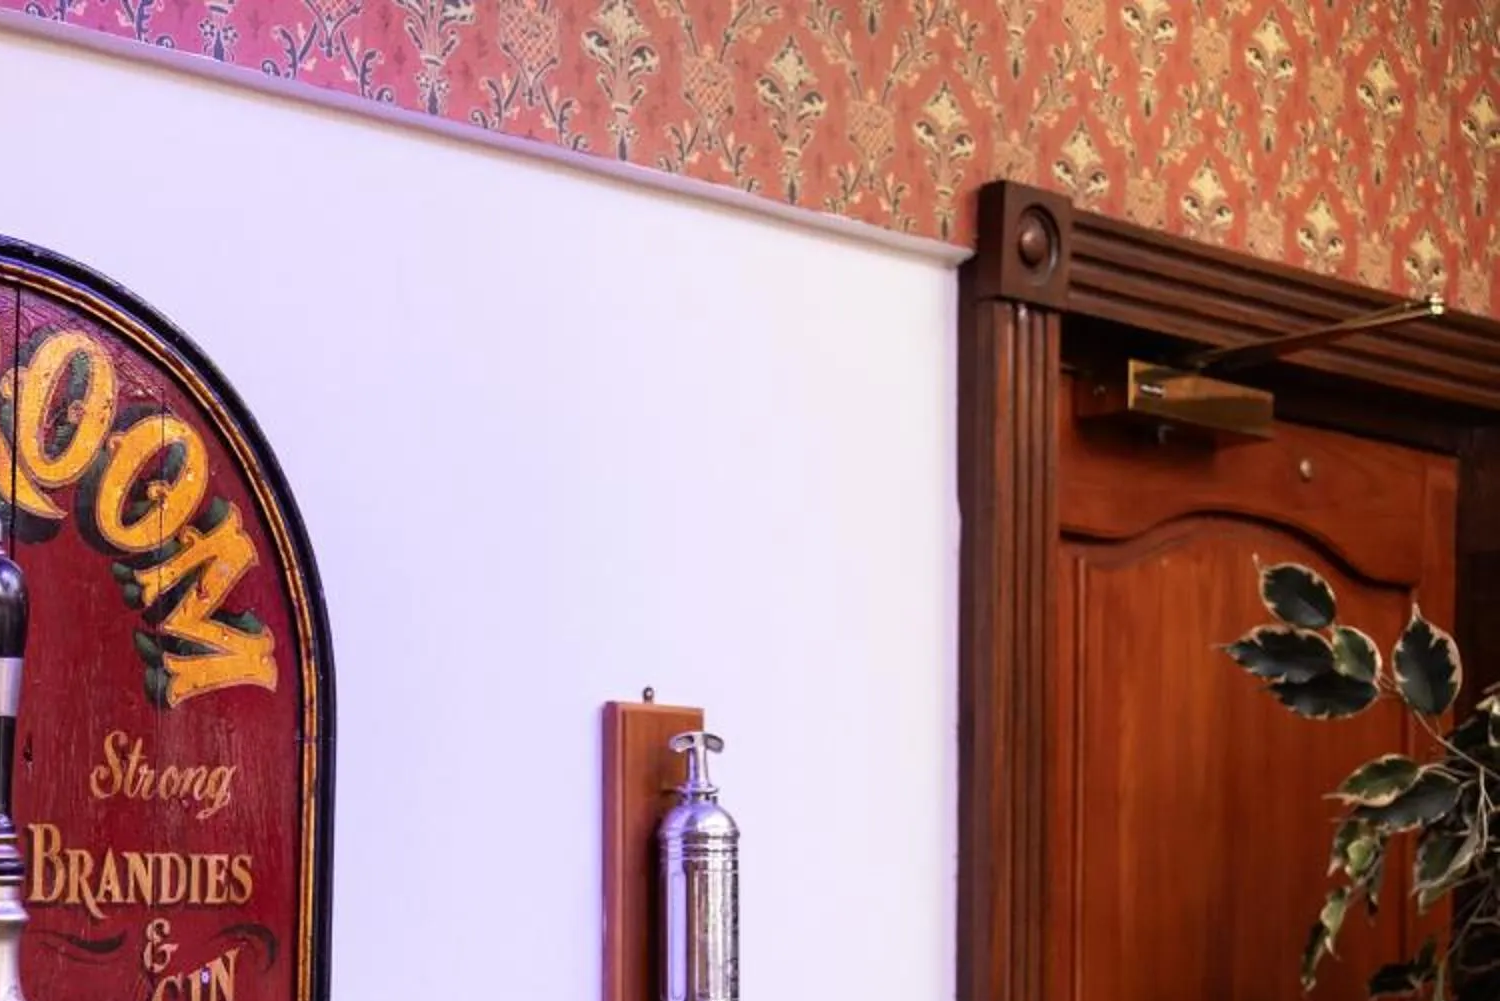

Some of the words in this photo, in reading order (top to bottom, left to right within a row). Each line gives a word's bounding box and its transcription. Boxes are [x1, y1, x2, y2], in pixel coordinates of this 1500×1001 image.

[89, 730, 238, 820] Strong
[27, 823, 254, 919] BRANDIES
[143, 917, 179, 972] &
